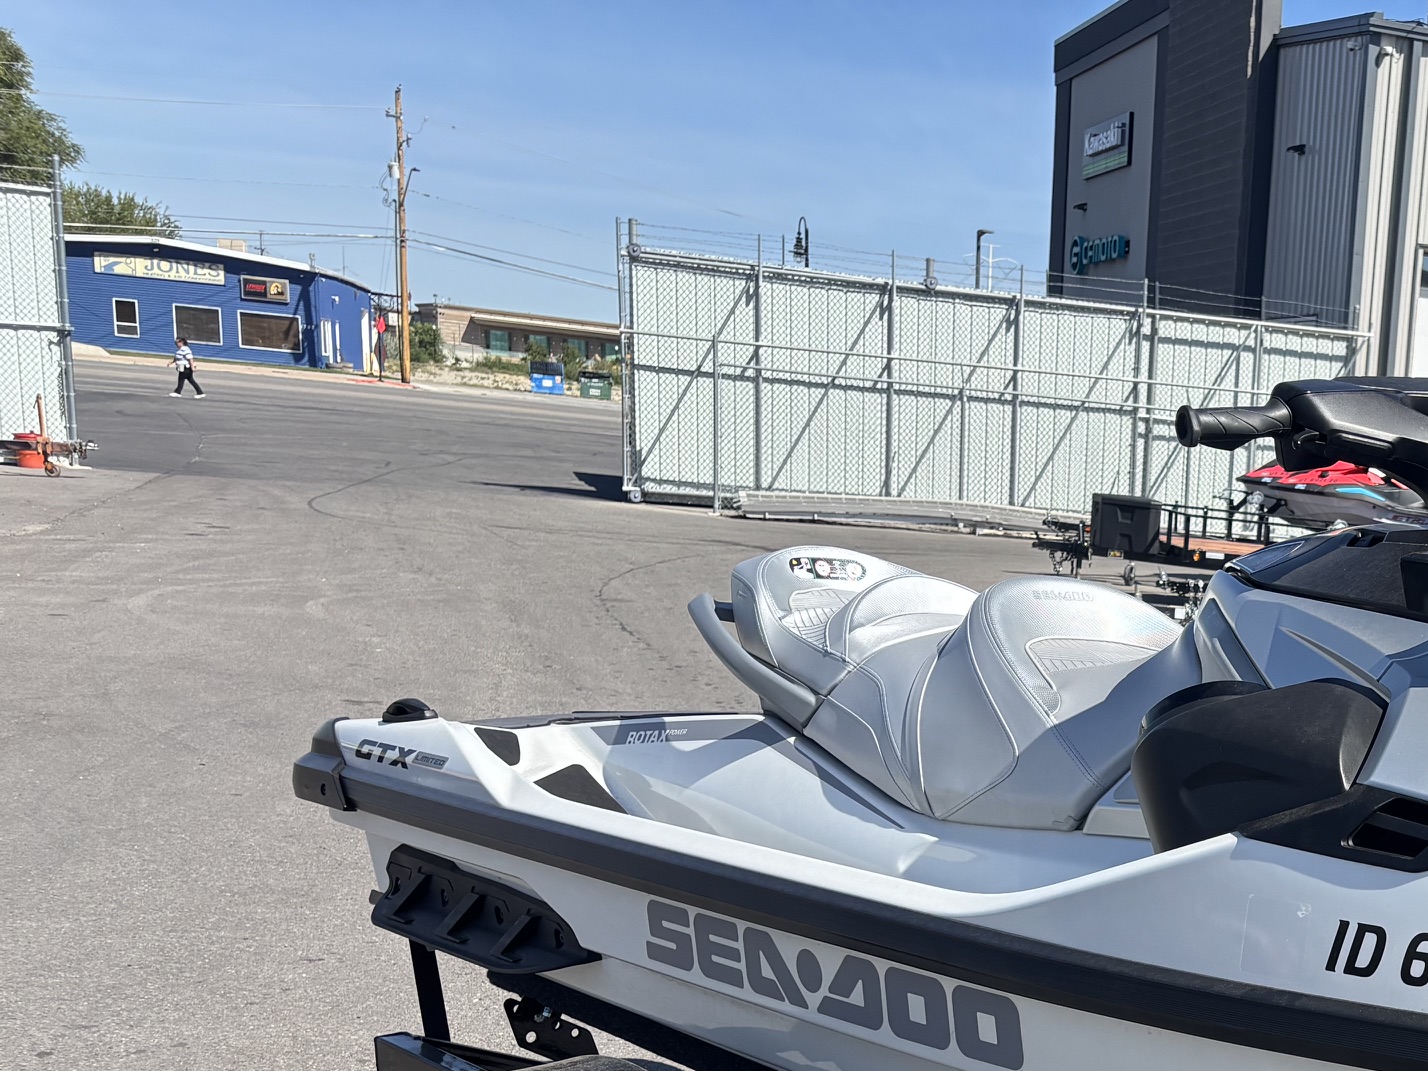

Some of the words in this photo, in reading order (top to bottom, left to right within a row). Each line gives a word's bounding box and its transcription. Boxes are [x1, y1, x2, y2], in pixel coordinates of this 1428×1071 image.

[1084, 121, 1120, 157] Kawasaki
[144, 257, 221, 279] JONES
[625, 729, 668, 745] ROTAX
[355, 738, 418, 770] GTX
[416, 754, 447, 767] LIMITED
[1325, 919, 1387, 978] ID
